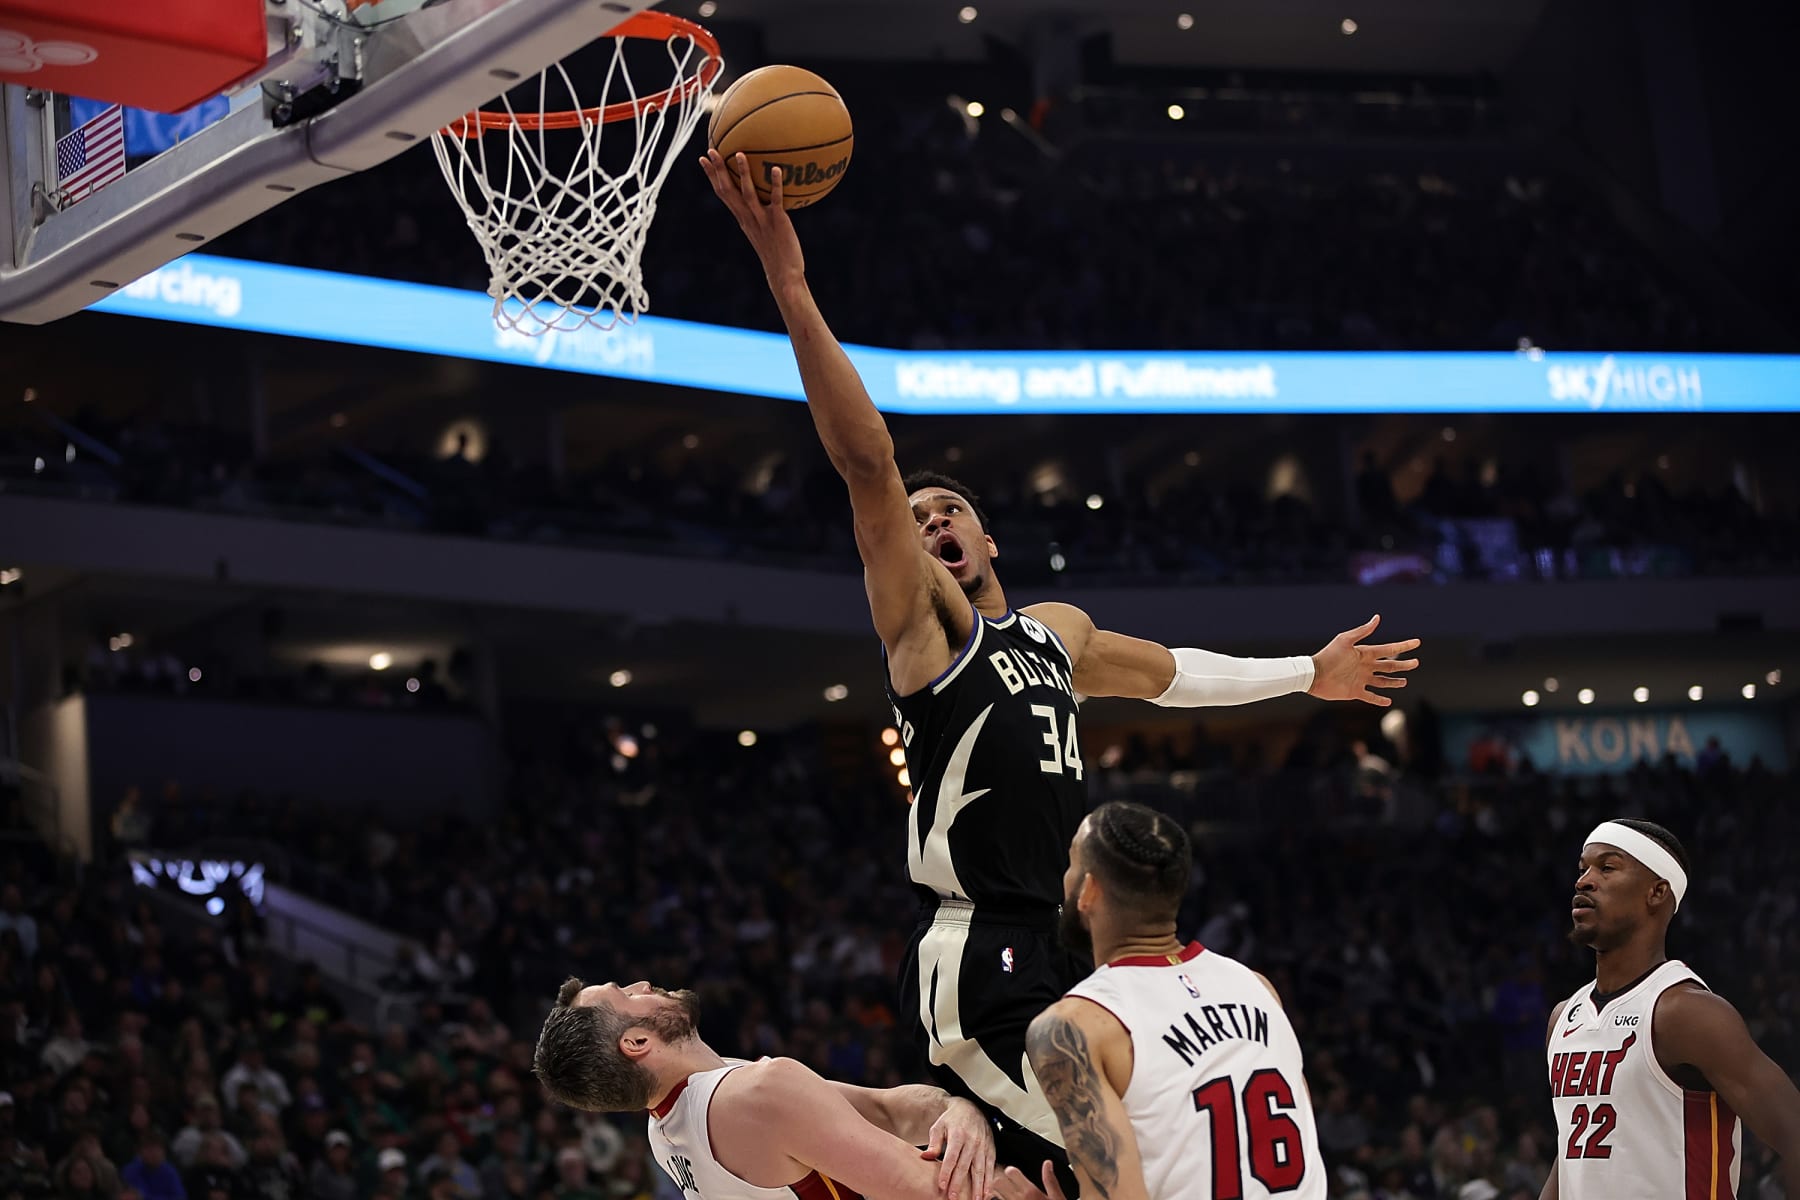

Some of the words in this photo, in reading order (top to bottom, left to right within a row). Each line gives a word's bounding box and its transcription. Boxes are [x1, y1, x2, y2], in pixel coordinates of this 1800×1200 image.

[762, 156, 848, 187] Wilson
[896, 360, 1020, 404] Kitting
[1024, 361, 1094, 398] and
[1031, 704, 1083, 780] 34
[1555, 716, 1698, 764] KONA
[1162, 1003, 1269, 1067] MARTIN
[1614, 1015, 1640, 1027] UKG
[1551, 1031, 1637, 1098] HEAT
[1192, 1067, 1306, 1200] 16
[1565, 1103, 1617, 1159] 22
